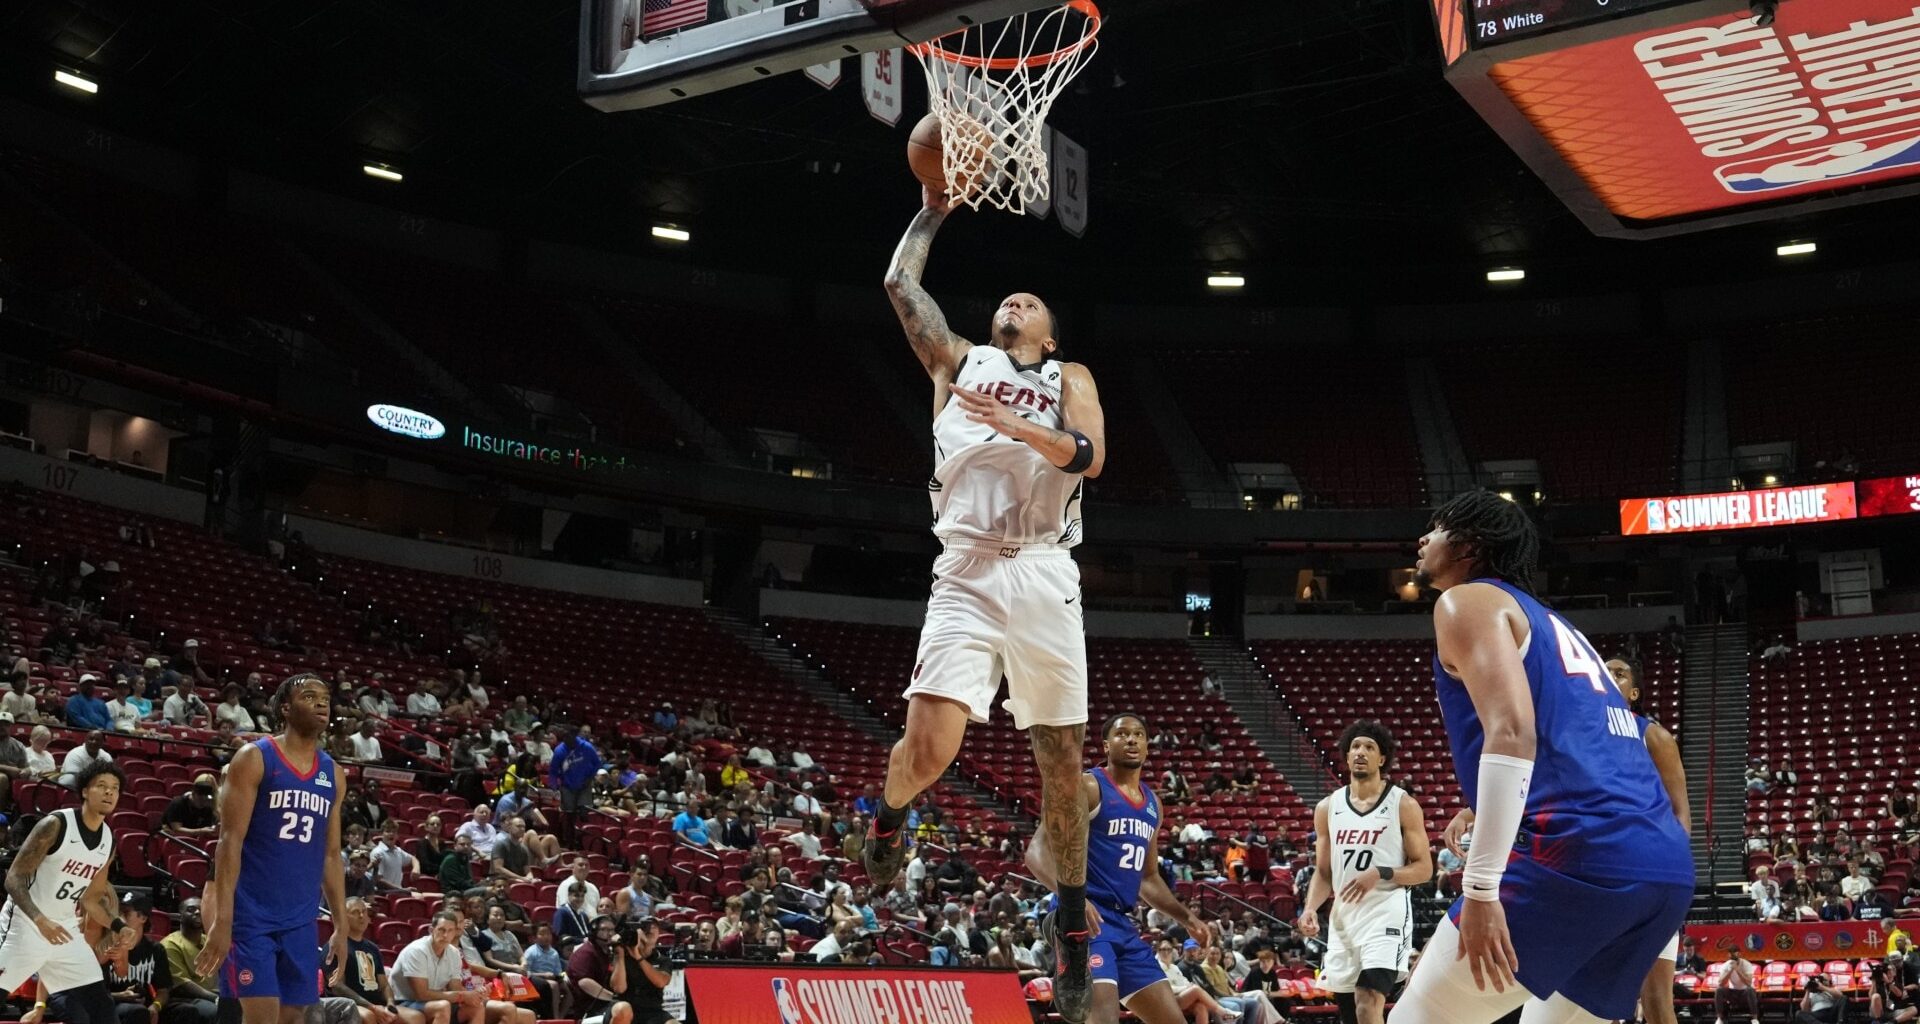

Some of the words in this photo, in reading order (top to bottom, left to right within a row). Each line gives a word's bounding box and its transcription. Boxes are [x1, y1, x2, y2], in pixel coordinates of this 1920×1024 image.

[1477, 21, 1497, 38] 78
[1502, 13, 1544, 31] White
[1633, 15, 1829, 157] SUMMER
[378, 408, 434, 430] COUNTRY
[464, 425, 561, 465] Insurance
[43, 463, 78, 491] 107
[1667, 493, 1751, 529] SUMMER
[1755, 488, 1828, 524] LEAGUE
[473, 556, 501, 578] 108
[1606, 705, 1640, 740] JIHA
[269, 789, 331, 818] DETROIT
[279, 811, 314, 843] 23
[1336, 826, 1387, 845] HEAT
[61, 858, 102, 880] HEAT
[1119, 843, 1145, 872] 20
[1343, 849, 1373, 871] 70
[55, 881, 88, 904] 64
